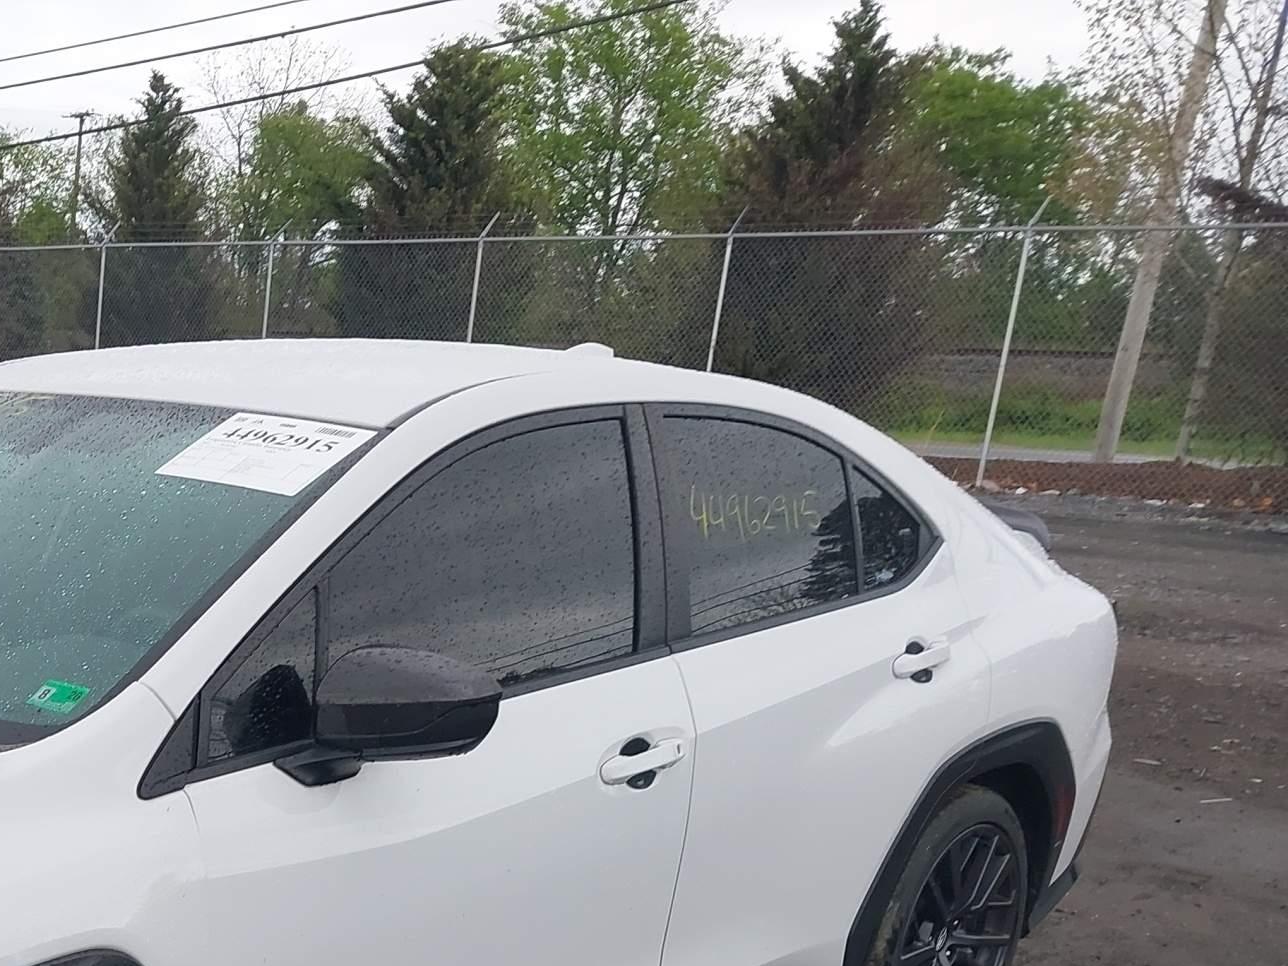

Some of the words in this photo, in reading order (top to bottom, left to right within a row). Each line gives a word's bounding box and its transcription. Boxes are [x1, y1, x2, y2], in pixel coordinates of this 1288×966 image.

[223, 427, 339, 453] 44962915
[690, 484, 821, 542] 44962915
[38, 688, 51, 700] 8
